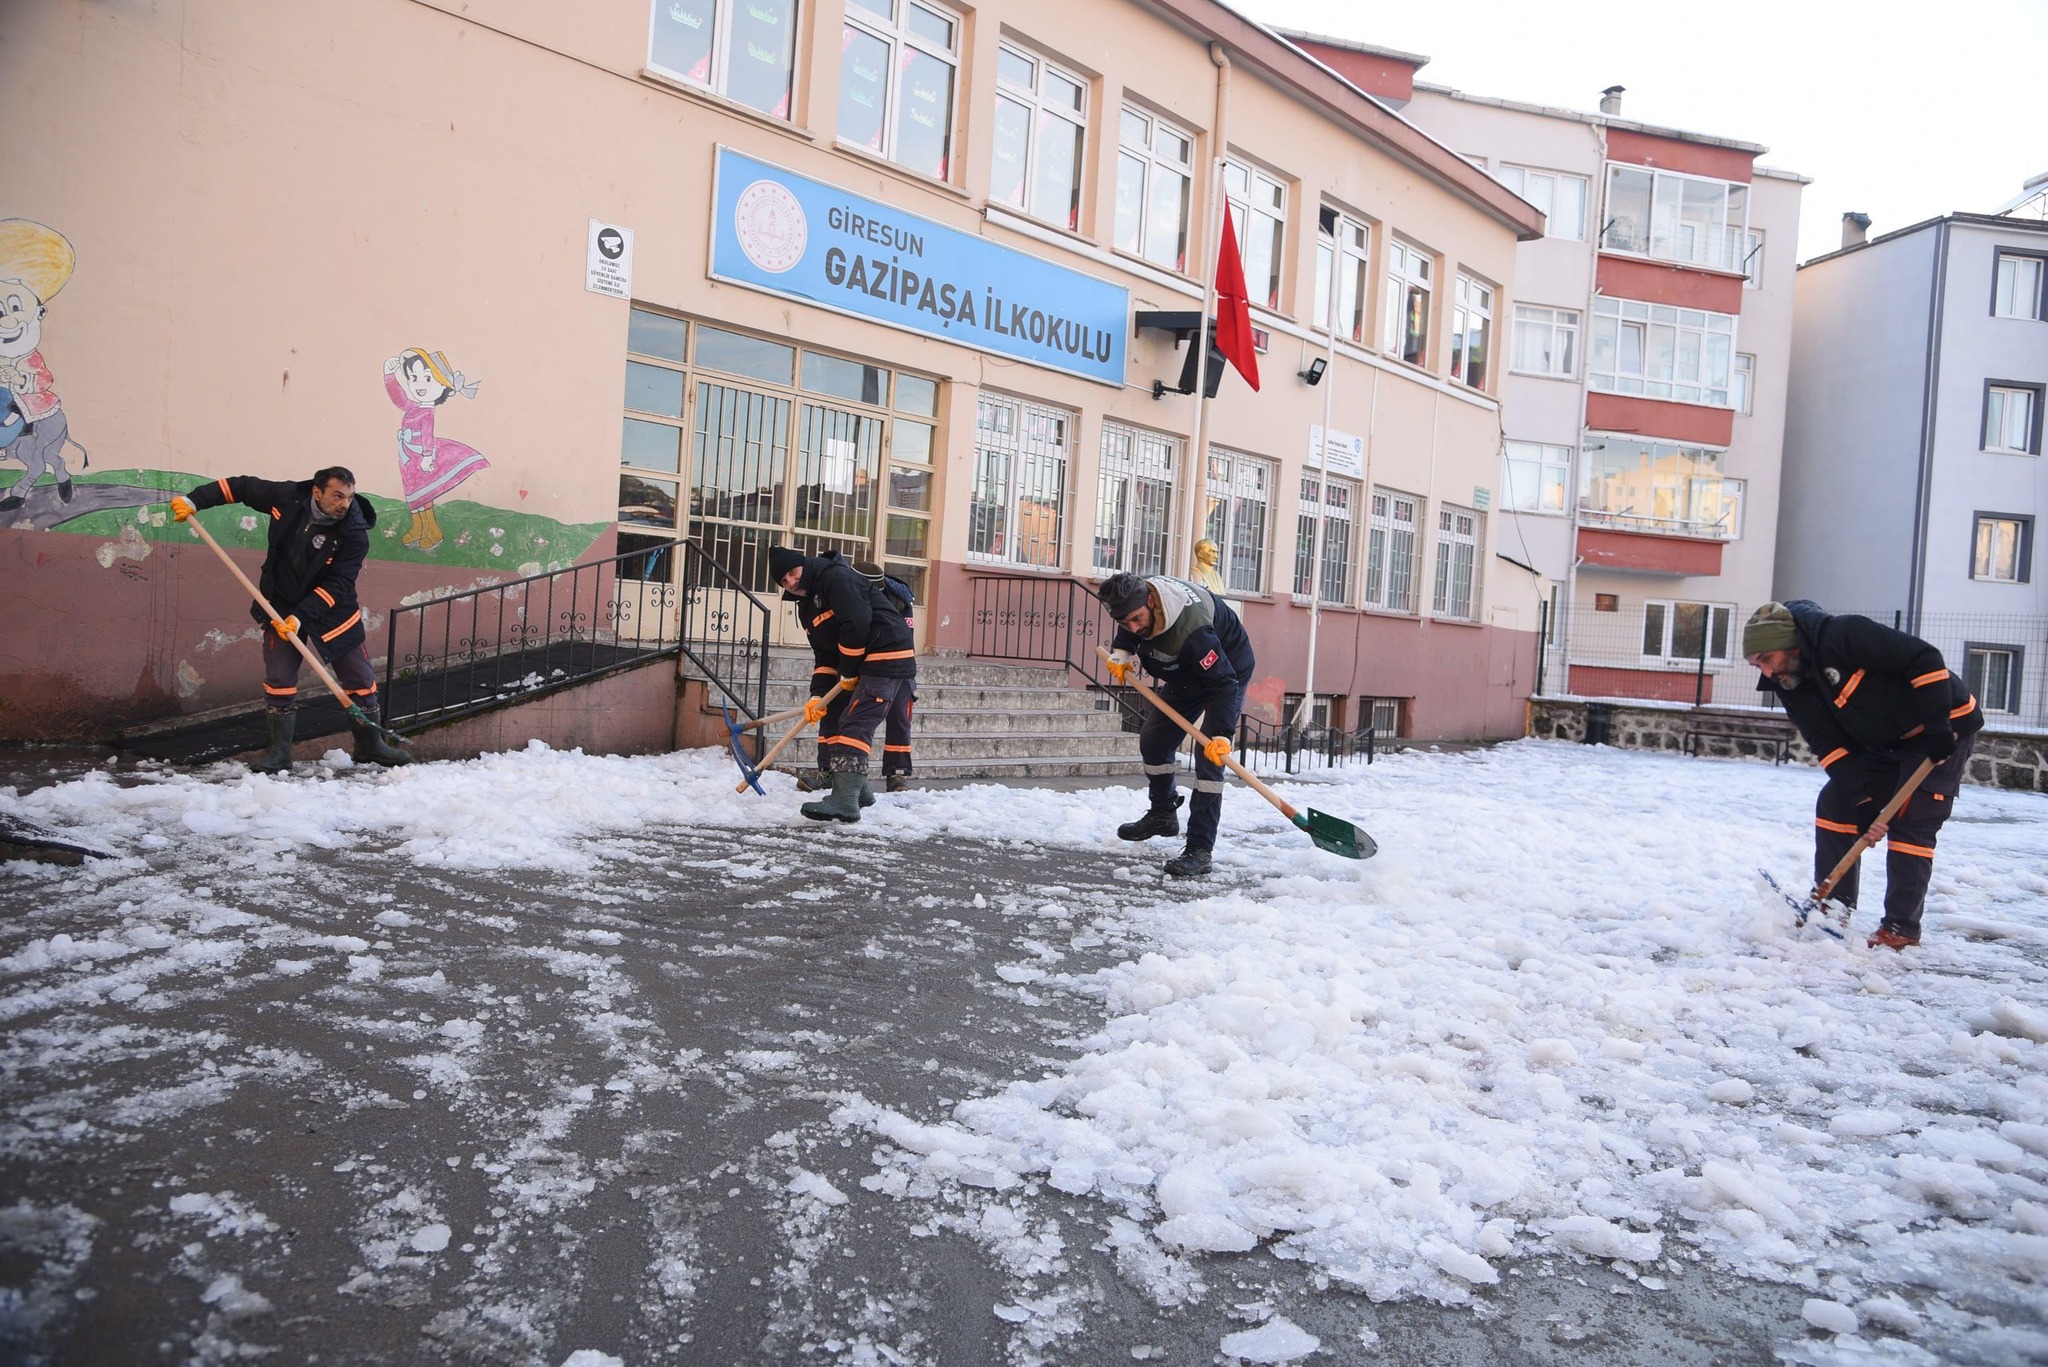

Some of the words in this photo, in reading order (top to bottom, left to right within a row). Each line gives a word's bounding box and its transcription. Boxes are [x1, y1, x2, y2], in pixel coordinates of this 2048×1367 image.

[828, 205, 924, 258] GİRESUN
[825, 247, 977, 328] GAZİPAŞA
[985, 286, 1112, 364] İLKOKULU
